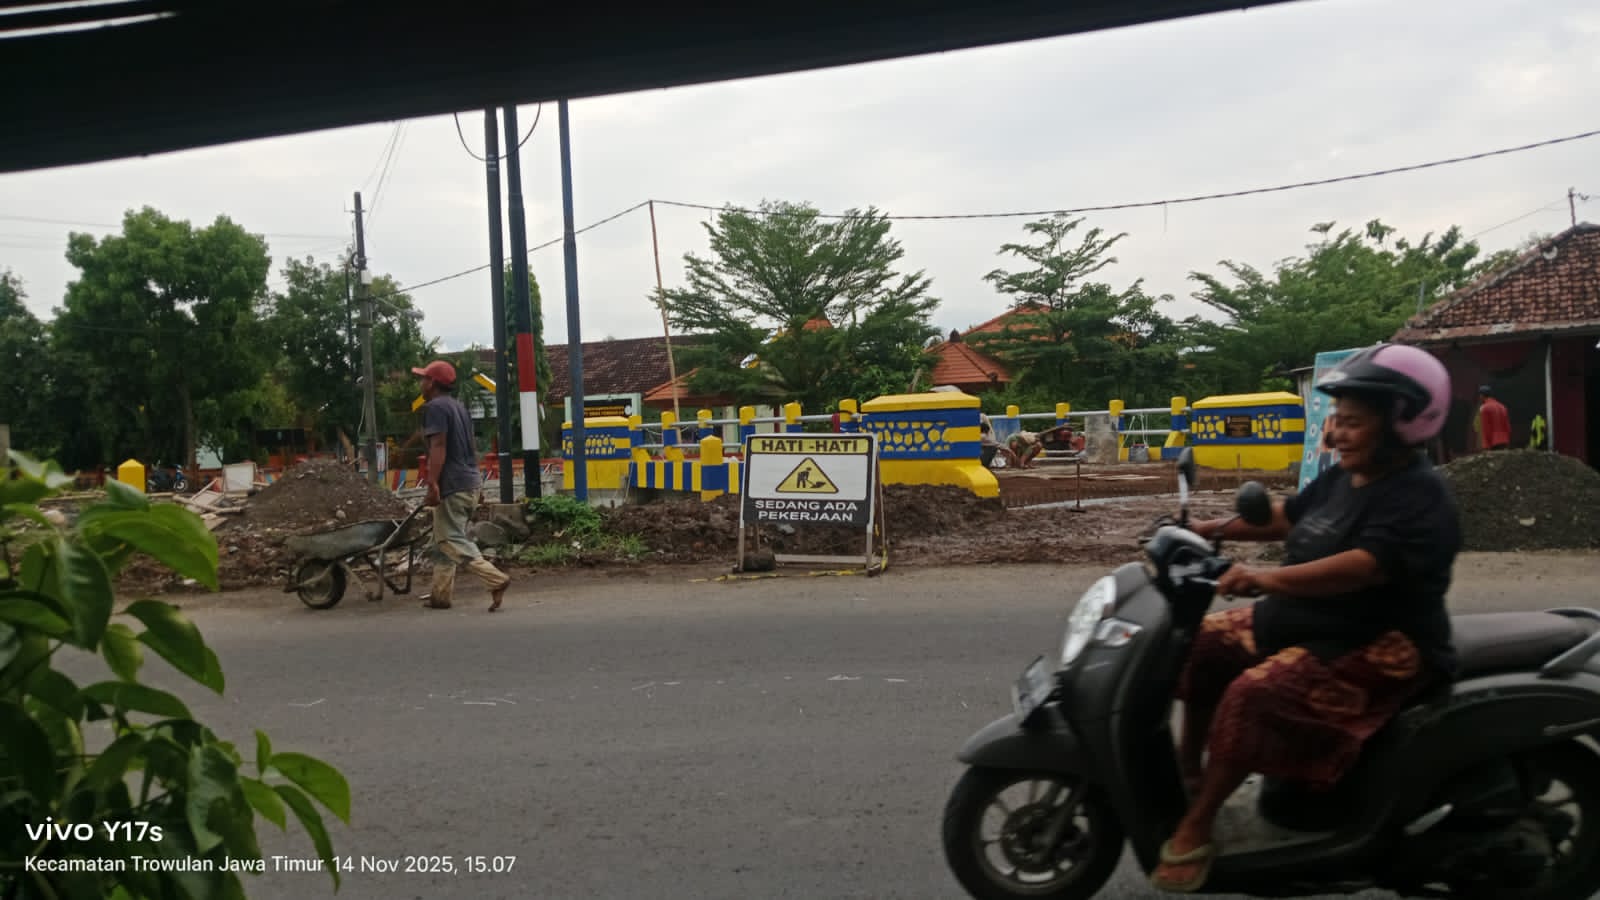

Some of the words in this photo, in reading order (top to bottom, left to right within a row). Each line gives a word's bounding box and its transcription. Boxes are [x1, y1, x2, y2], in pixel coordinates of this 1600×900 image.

[761, 440, 803, 452] HATI
[755, 500, 820, 510] SEDANG
[824, 502, 858, 511] ADA
[758, 511, 853, 521] PEKERJAAN
